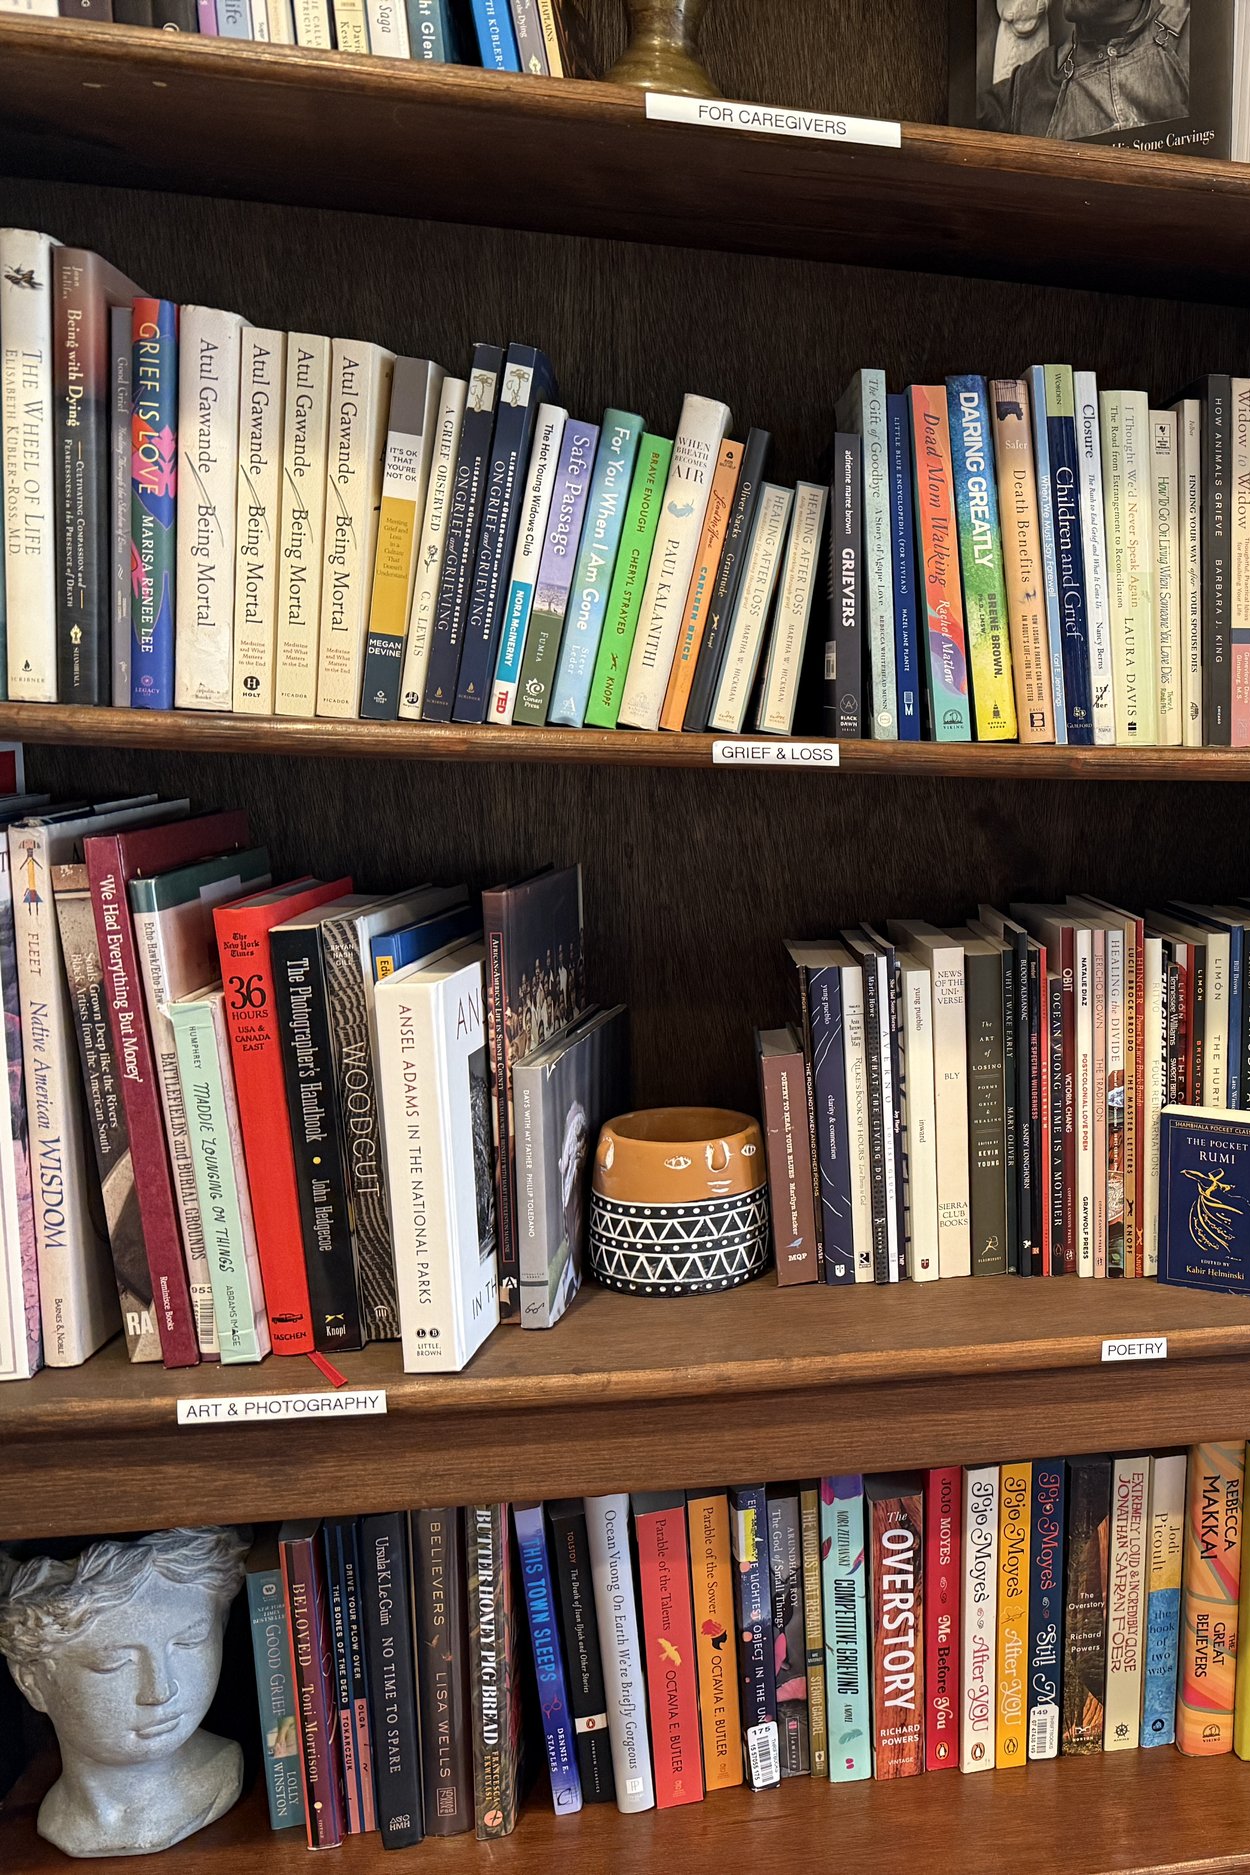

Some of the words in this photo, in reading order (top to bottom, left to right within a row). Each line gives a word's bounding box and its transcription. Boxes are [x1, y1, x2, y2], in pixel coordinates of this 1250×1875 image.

[699, 105, 734, 122] FOR
[738, 110, 847, 136] CAREGIVERS
[1133, 140, 1163, 151] Stone
[1166, 130, 1215, 148] Carvings
[66, 309, 82, 351] Being
[68, 354, 84, 382] with
[139, 322, 160, 401] GRIEF
[201, 340, 218, 381] Atul
[253, 344, 271, 386] Atul
[66, 385, 83, 427] Dying
[139, 403, 160, 421] IS
[199, 385, 218, 474] Gawande
[250, 388, 269, 475] Gawande
[611, 427, 629, 454] For
[960, 392, 985, 473] DARING
[138, 429, 160, 495] LOVE
[569, 436, 590, 476] Safe
[605, 460, 624, 487] You
[190, 504, 216, 557] Being
[240, 505, 266, 556] Being
[550, 480, 582, 557] Passage
[594, 493, 617, 538] When
[968, 476, 994, 569] GREATLY
[1056, 466, 1074, 555] Children
[142, 516, 154, 570] MARISA
[585, 553, 604, 582] Am
[841, 548, 855, 627] GRIEVERS
[1062, 555, 1076, 588] and
[142, 574, 153, 623] RENEE
[196, 561, 215, 627] Mortal
[245, 560, 263, 624] Mortal
[577, 588, 600, 631] Gone
[1063, 589, 1083, 640] Grief
[141, 626, 153, 653] LEE
[368, 647, 401, 658] DEVINE
[370, 637, 402, 649] MEGAN
[722, 746, 771, 759] GRIEF
[777, 748, 785, 759] &
[792, 748, 833, 760] LOSS
[230, 975, 265, 1008] 36
[287, 961, 302, 983] The
[1062, 968, 1073, 993] OBIT
[30, 1001, 46, 1053] Native
[232, 1009, 269, 1020] HOURS
[289, 986, 314, 1076] Photographer's
[399, 1003, 415, 1053] ANSEL
[32, 1058, 50, 1130] American
[402, 1059, 419, 1117] ADAMS
[944, 1072, 960, 1080] BLY
[301, 1082, 323, 1142] Handbook
[341, 1041, 381, 1198] WOODCUT
[407, 1123, 419, 1140] IN
[409, 1148, 422, 1174] THE
[1187, 1138, 1207, 1148] THE
[1210, 1140, 1249, 1151] POCKET
[1200, 1151, 1236, 1165] RUMI
[38, 1135, 67, 1249] WISDOM
[412, 1178, 428, 1256] NATIONAL
[417, 1262, 431, 1305] PARKS
[1186, 1264, 1205, 1275] Kabir
[1207, 1267, 1245, 1280] Helminski
[1108, 1341, 1163, 1356] POETRY
[186, 1401, 223, 1417] ART
[228, 1402, 240, 1416] &
[244, 1396, 379, 1415] PHOTOGRAPHY
[888, 1512, 908, 1522] The
[971, 1482, 994, 1525] Jojo
[1200, 1475, 1221, 1560] MAKKAI
[1223, 1478, 1239, 1552] REBECCA
[430, 1522, 444, 1625] BELIEVERS
[522, 1538, 543, 1573] THIS
[969, 1528, 994, 1602] Moyes
[527, 1578, 549, 1622] TOWN
[834, 1578, 857, 1644] COMPETITIVE
[881, 1529, 915, 1710] OVERSTORY
[533, 1629, 556, 1681] SLEEPS
[836, 1646, 860, 1695] GRIEVING
[435, 1672, 447, 1713] LISA
[666, 1670, 679, 1720] OCTAVIA
[438, 1720, 450, 1778] WELLS
[668, 1723, 680, 1732] E.
[880, 1724, 920, 1736] RICHARD
[882, 1734, 919, 1746] POWERS
[669, 1735, 682, 1773] BUTLER
